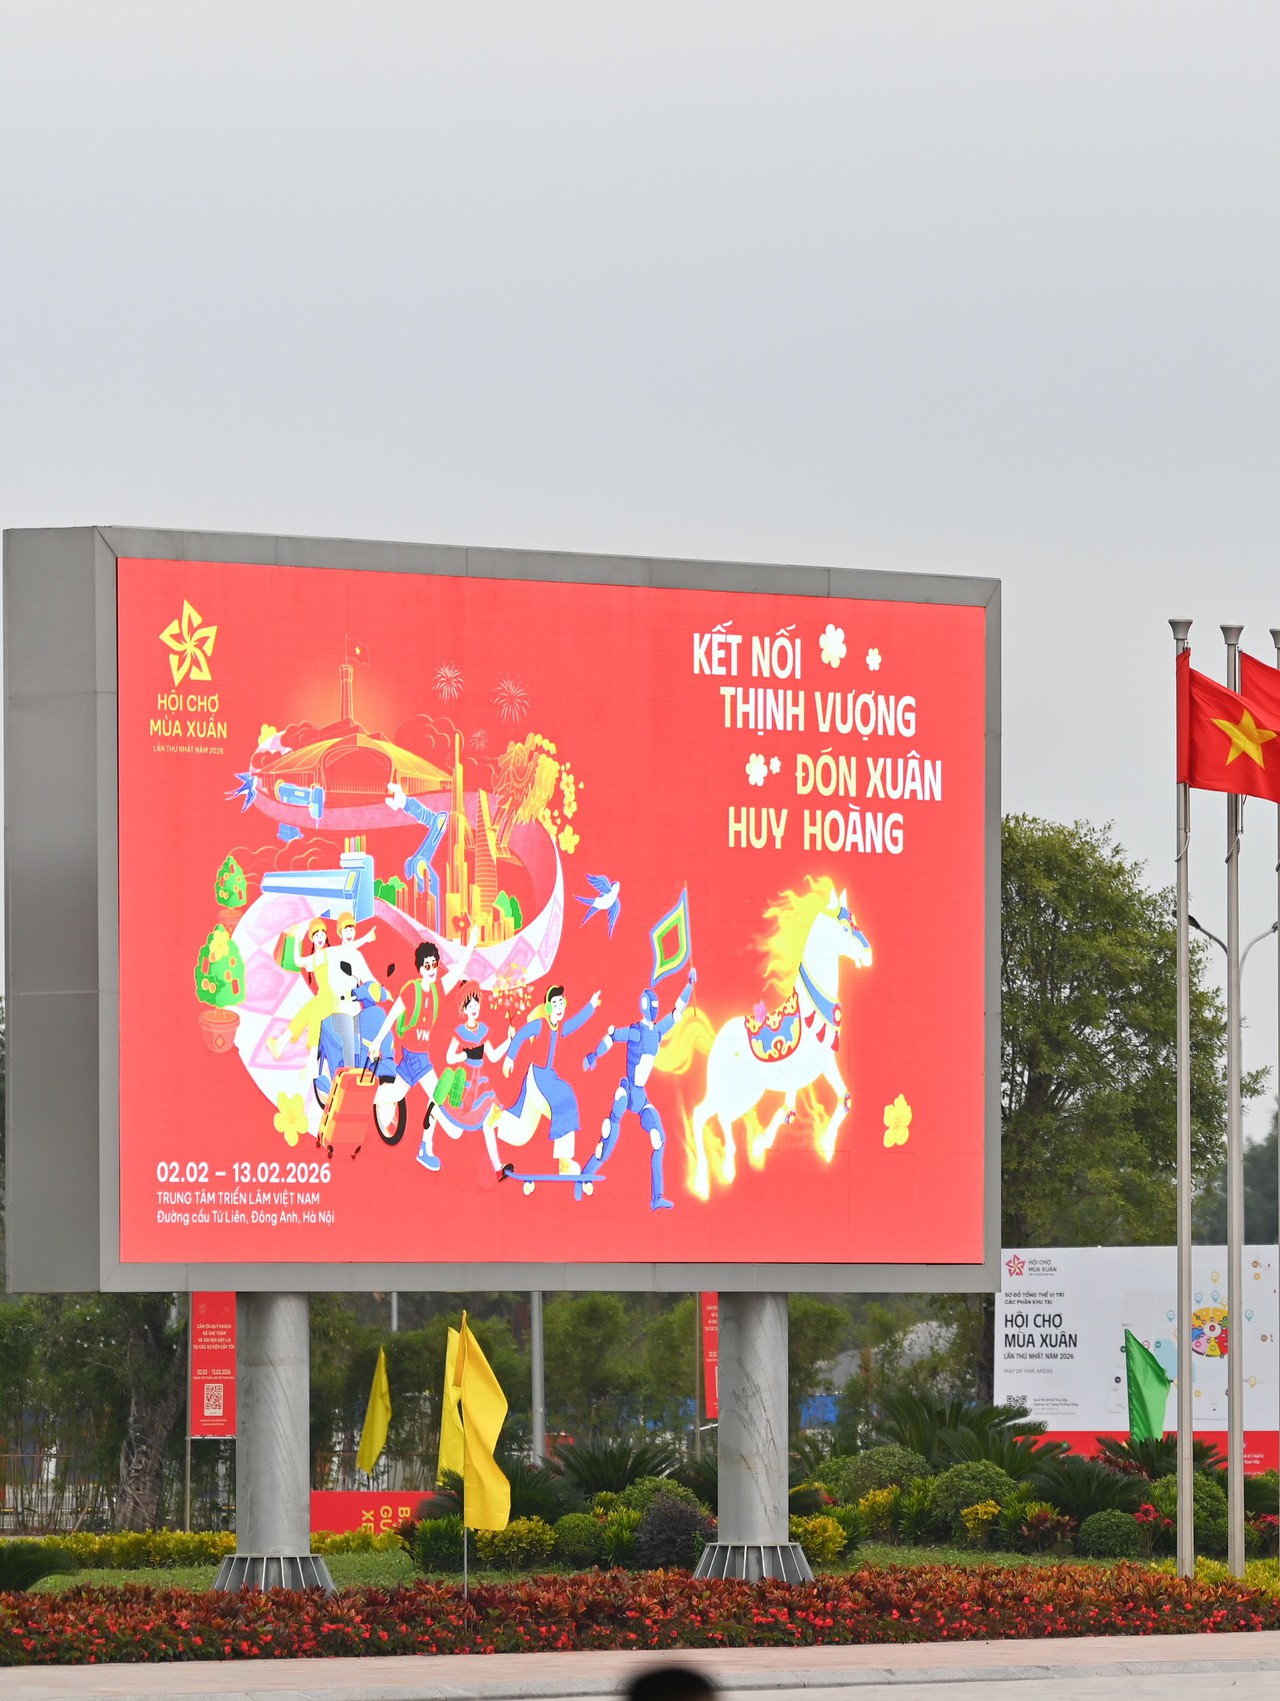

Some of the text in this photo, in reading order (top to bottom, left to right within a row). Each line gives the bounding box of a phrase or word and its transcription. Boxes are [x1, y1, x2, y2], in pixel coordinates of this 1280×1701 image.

[693, 620, 801, 679] KẾT NỐI
[157, 689, 219, 717] HỘI CHỢ
[720, 686, 916, 741] THỊNH VƯỢNG
[150, 715, 227, 739] MÙA XUÂN
[209, 746, 224, 755] 2026
[795, 747, 942, 801] ĐÓN XUÂN
[728, 803, 904, 854] HUY HOÀNG
[416, 1028, 430, 1042] VN
[156, 1161, 209, 1183] 02.02
[232, 1162, 331, 1183] 13.02.2026
[157, 1186, 320, 1208] TRUNG TÂM TRIỂN LÃM VIỆT NAM
[157, 1209, 335, 1226] Đường cầu Tứ Liên, Đông Anh, Hà Nội
[1004, 1311, 1063, 1330] HỘI CHỢ
[1004, 1330, 1078, 1348] MÙA XUÂN
